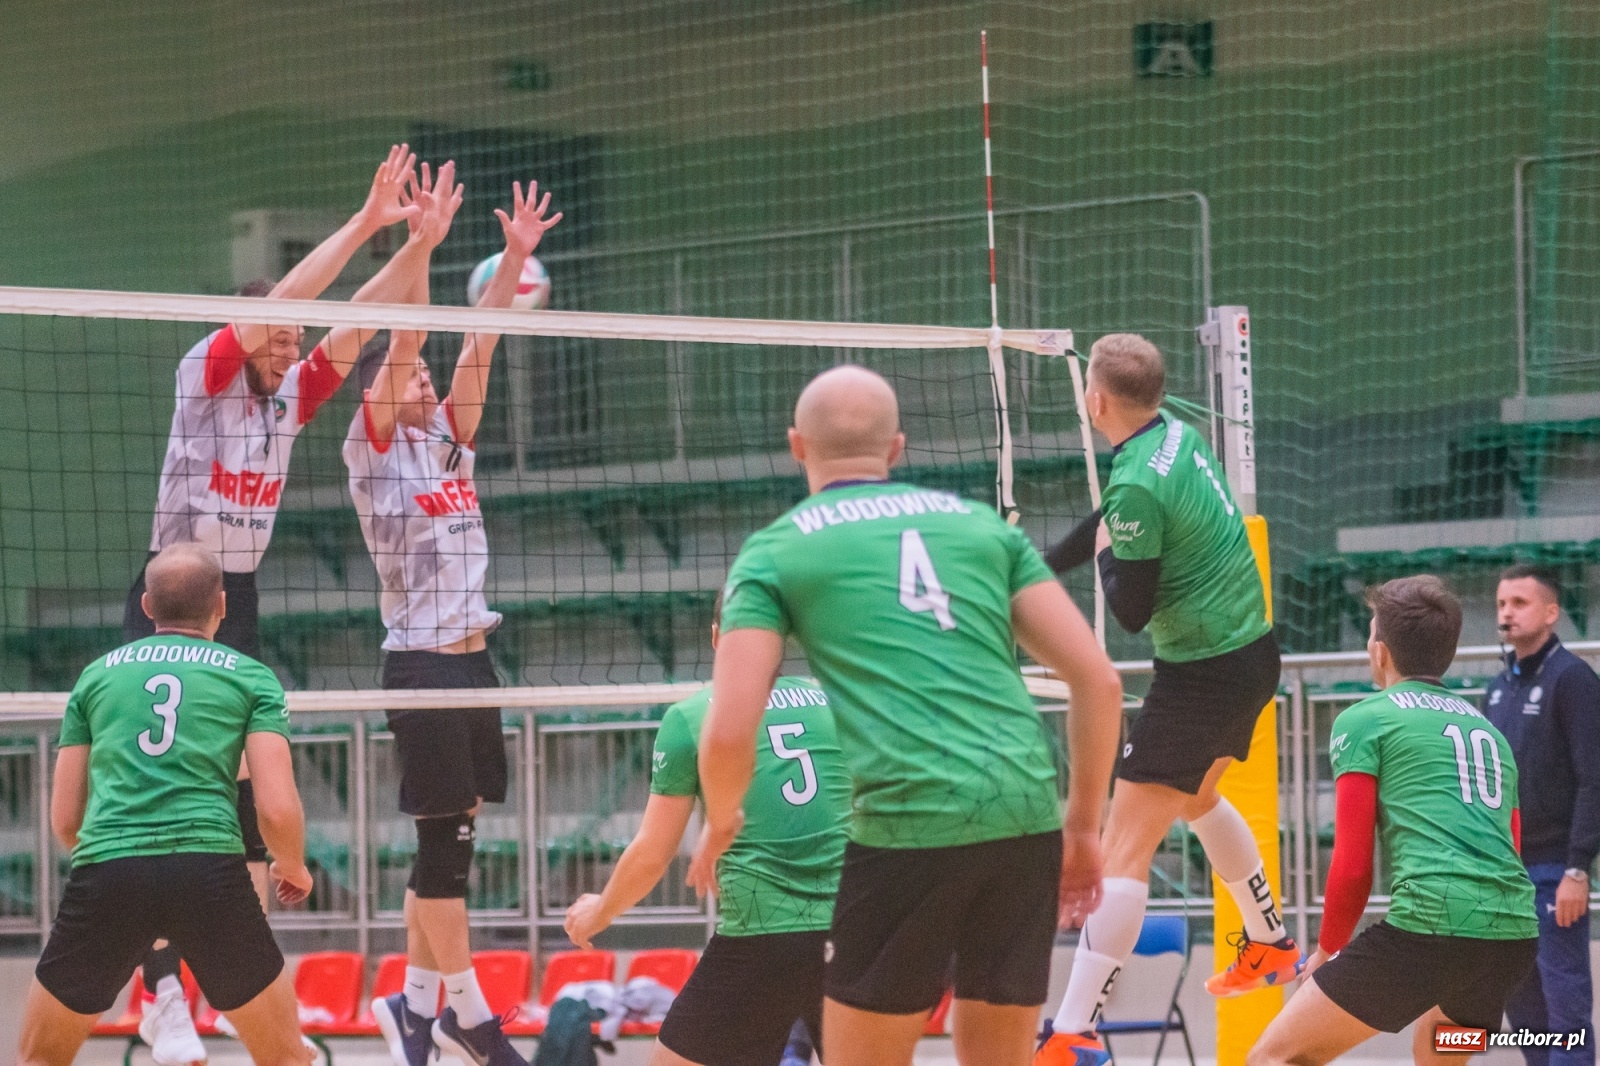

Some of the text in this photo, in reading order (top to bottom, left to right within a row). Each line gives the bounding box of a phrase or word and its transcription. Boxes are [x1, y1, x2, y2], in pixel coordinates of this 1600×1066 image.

[445, 444, 462, 472] 11
[1193, 449, 1235, 517] 1
[791, 490, 972, 536] WŁODOWICE
[1110, 512, 1145, 537] Jura
[898, 528, 957, 632] 4
[105, 645, 239, 671] WŁODOWICE
[137, 673, 183, 757] 3
[766, 721, 819, 807] 5
[1442, 723, 1503, 811] 10
